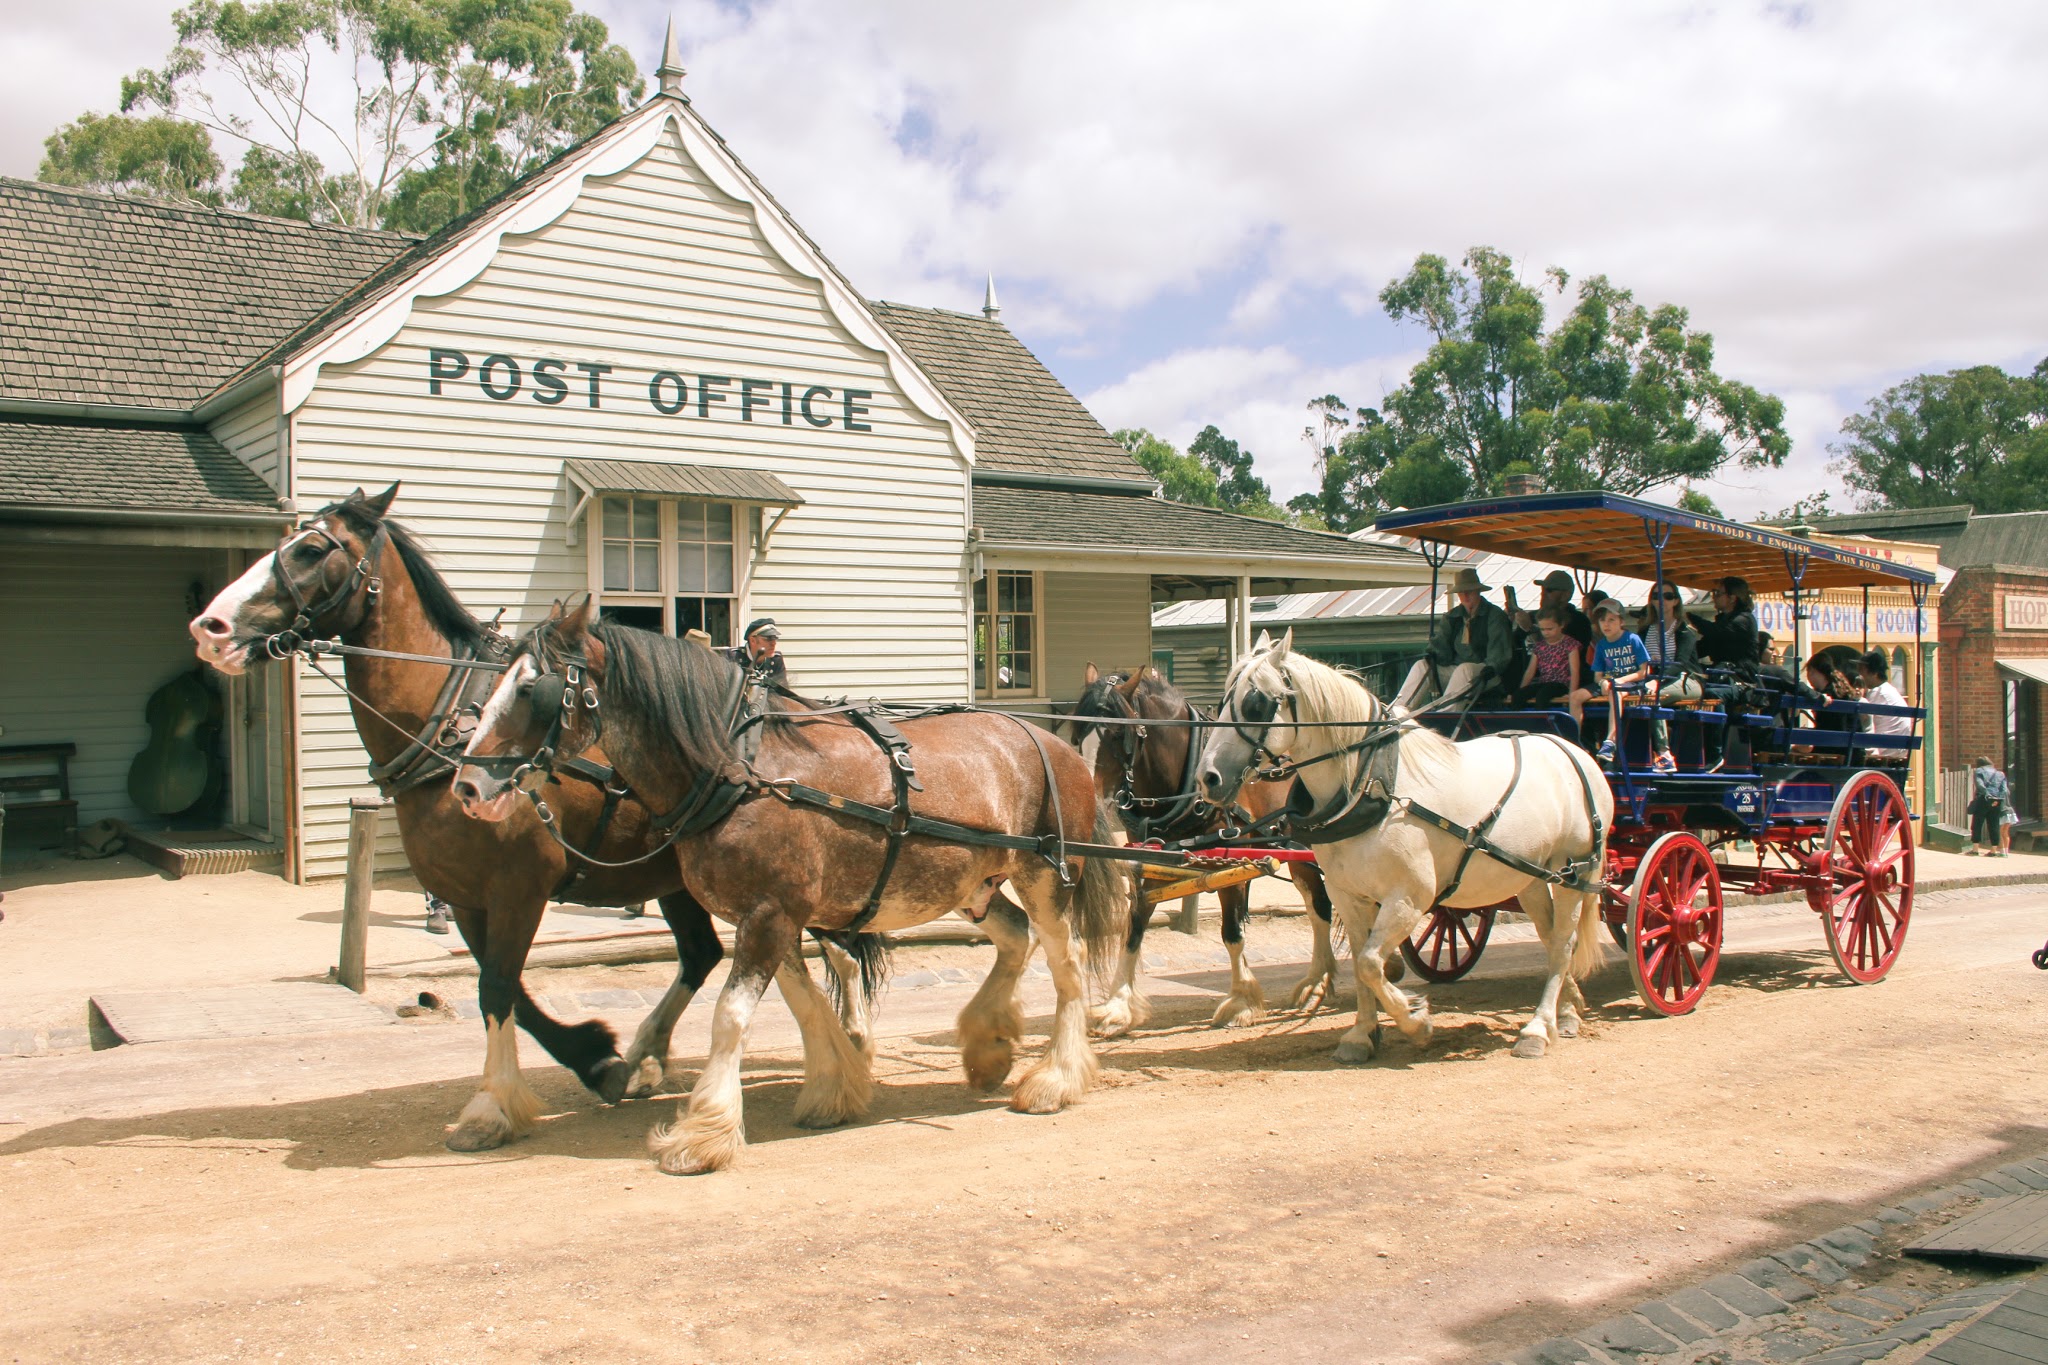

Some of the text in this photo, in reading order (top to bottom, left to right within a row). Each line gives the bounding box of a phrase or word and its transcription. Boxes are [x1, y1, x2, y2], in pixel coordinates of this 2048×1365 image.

[429, 348, 873, 432] POST OFFICE
[1695, 519, 1811, 554] REYNOLDS & ENGLISH
[1834, 553, 1856, 565] MAIN
[1859, 558, 1881, 571] ROAD
[1876, 608, 1928, 633] ROOMS
[2009, 600, 2048, 625] HOP
[1604, 645, 1632, 658] WHAT
[1613, 655, 1636, 667] TIME
